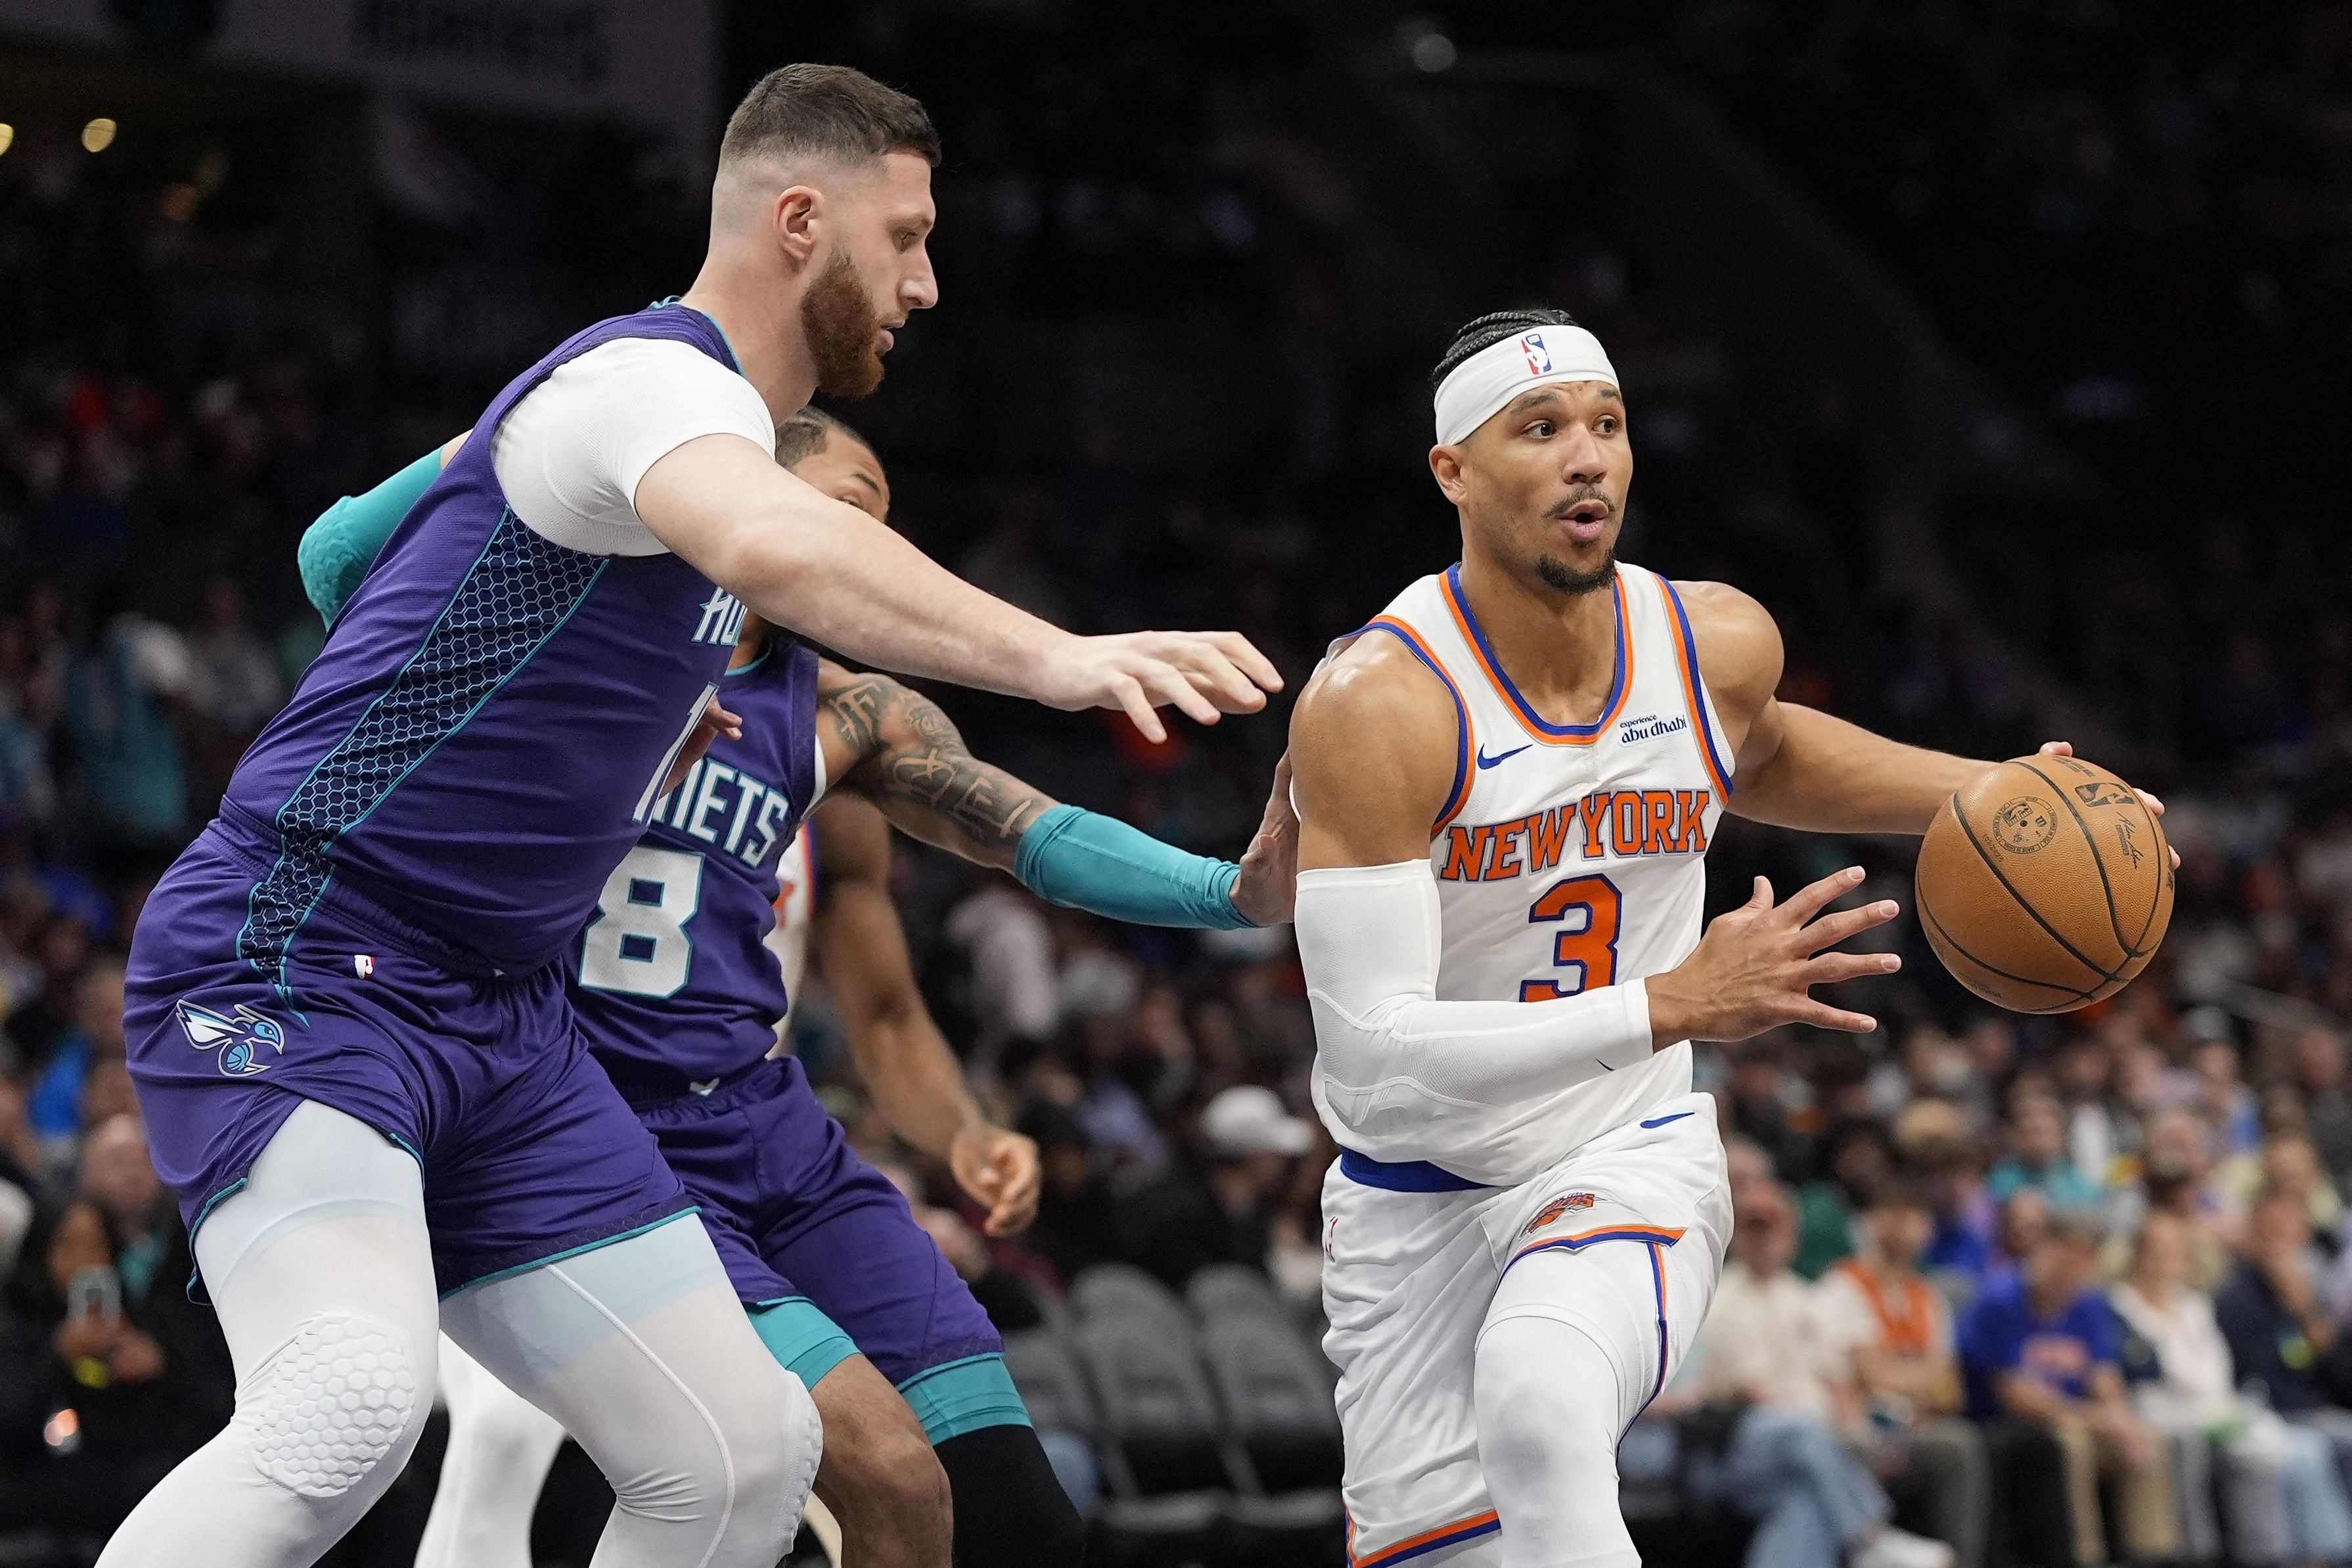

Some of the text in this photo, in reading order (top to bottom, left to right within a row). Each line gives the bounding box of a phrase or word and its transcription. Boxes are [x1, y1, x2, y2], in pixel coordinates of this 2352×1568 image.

[1619, 715, 1657, 728] experience
[1621, 715, 1687, 744] abu dhabi
[1439, 790, 1709, 882] NEW YORK
[579, 844, 706, 1000] 8
[1519, 873, 1623, 1002] 3
